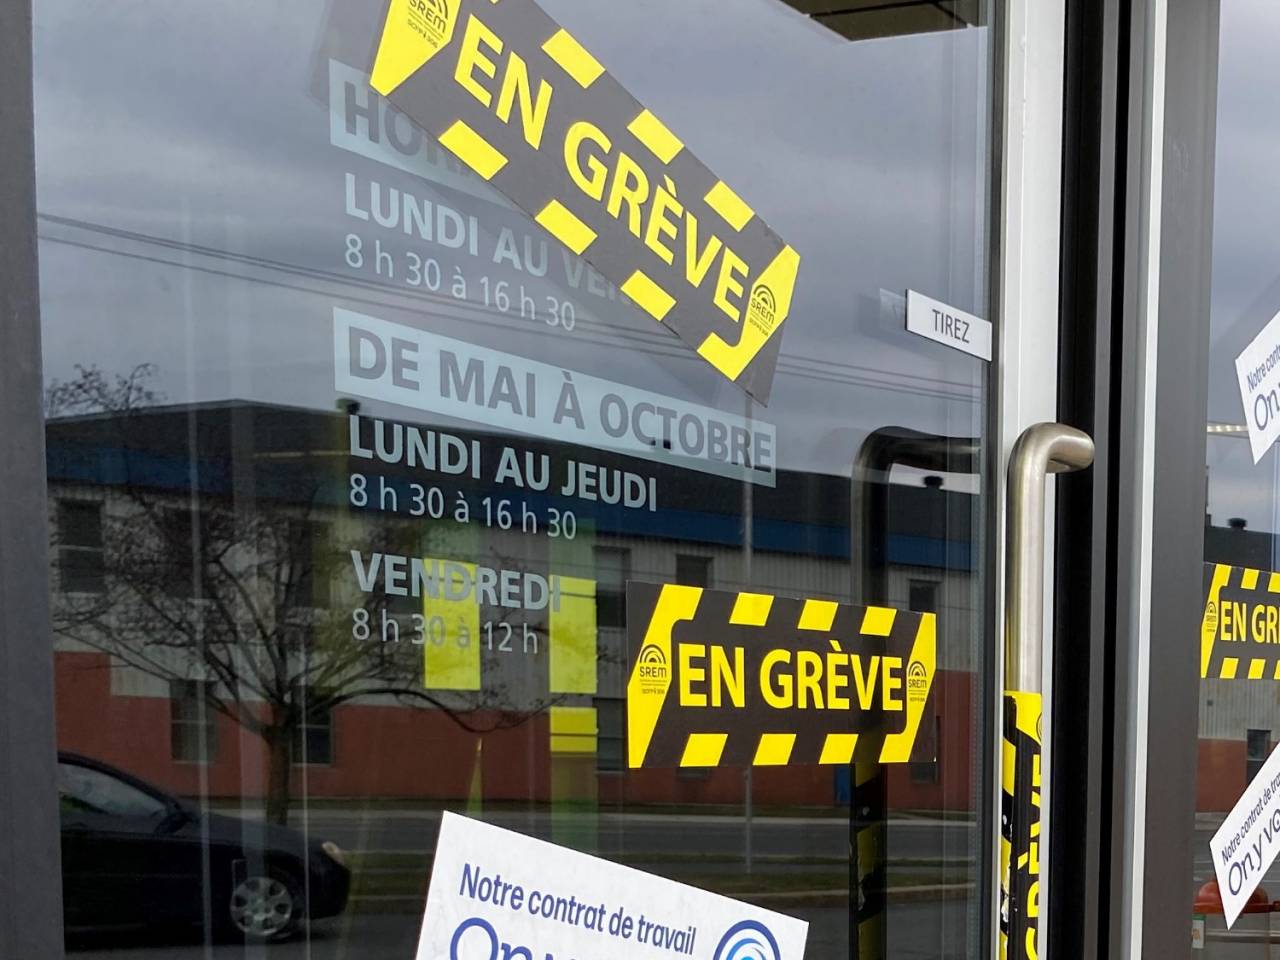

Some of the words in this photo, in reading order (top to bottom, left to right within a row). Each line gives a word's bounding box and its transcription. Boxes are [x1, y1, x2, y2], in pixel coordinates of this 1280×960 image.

[454, 13, 553, 150] EN
[563, 121, 750, 322] GRÈVE
[345, 172, 479, 256] LUNDI
[493, 227, 548, 277] AU
[345, 234, 363, 268] 8
[375, 240, 394, 278] h
[406, 252, 441, 291] 30
[452, 267, 467, 300] à
[480, 276, 510, 312] 16
[520, 286, 536, 320] h
[546, 296, 575, 331] 30
[932, 309, 970, 344] TIREZ
[348, 326, 420, 391] DE
[438, 349, 536, 419] MAI
[552, 370, 586, 430] À
[600, 393, 772, 473] OCTOBRE
[1254, 389, 1280, 431] On
[350, 414, 481, 478] LUNDI
[495, 446, 550, 491] AU
[561, 460, 657, 512] JEUDI
[350, 473, 368, 507] 8
[380, 475, 398, 511] h
[409, 484, 444, 520] 30
[454, 486, 470, 522] à
[482, 497, 512, 530] 16
[522, 500, 537, 534] h
[547, 507, 577, 540] 30
[350, 549, 561, 612] VENDREDI
[351, 608, 369, 641] 8
[381, 608, 399, 643] h
[411, 613, 446, 646] 30
[484, 621, 513, 652] 12
[524, 622, 538, 654] h
[1220, 600, 1247, 641] EN
[678, 642, 745, 707] EN
[759, 639, 903, 711] GRÈVE
[1228, 852, 1254, 896] On
[459, 863, 524, 911] Notre
[528, 890, 606, 932] contrat
[609, 906, 633, 940] de
[636, 919, 697, 955] travail
